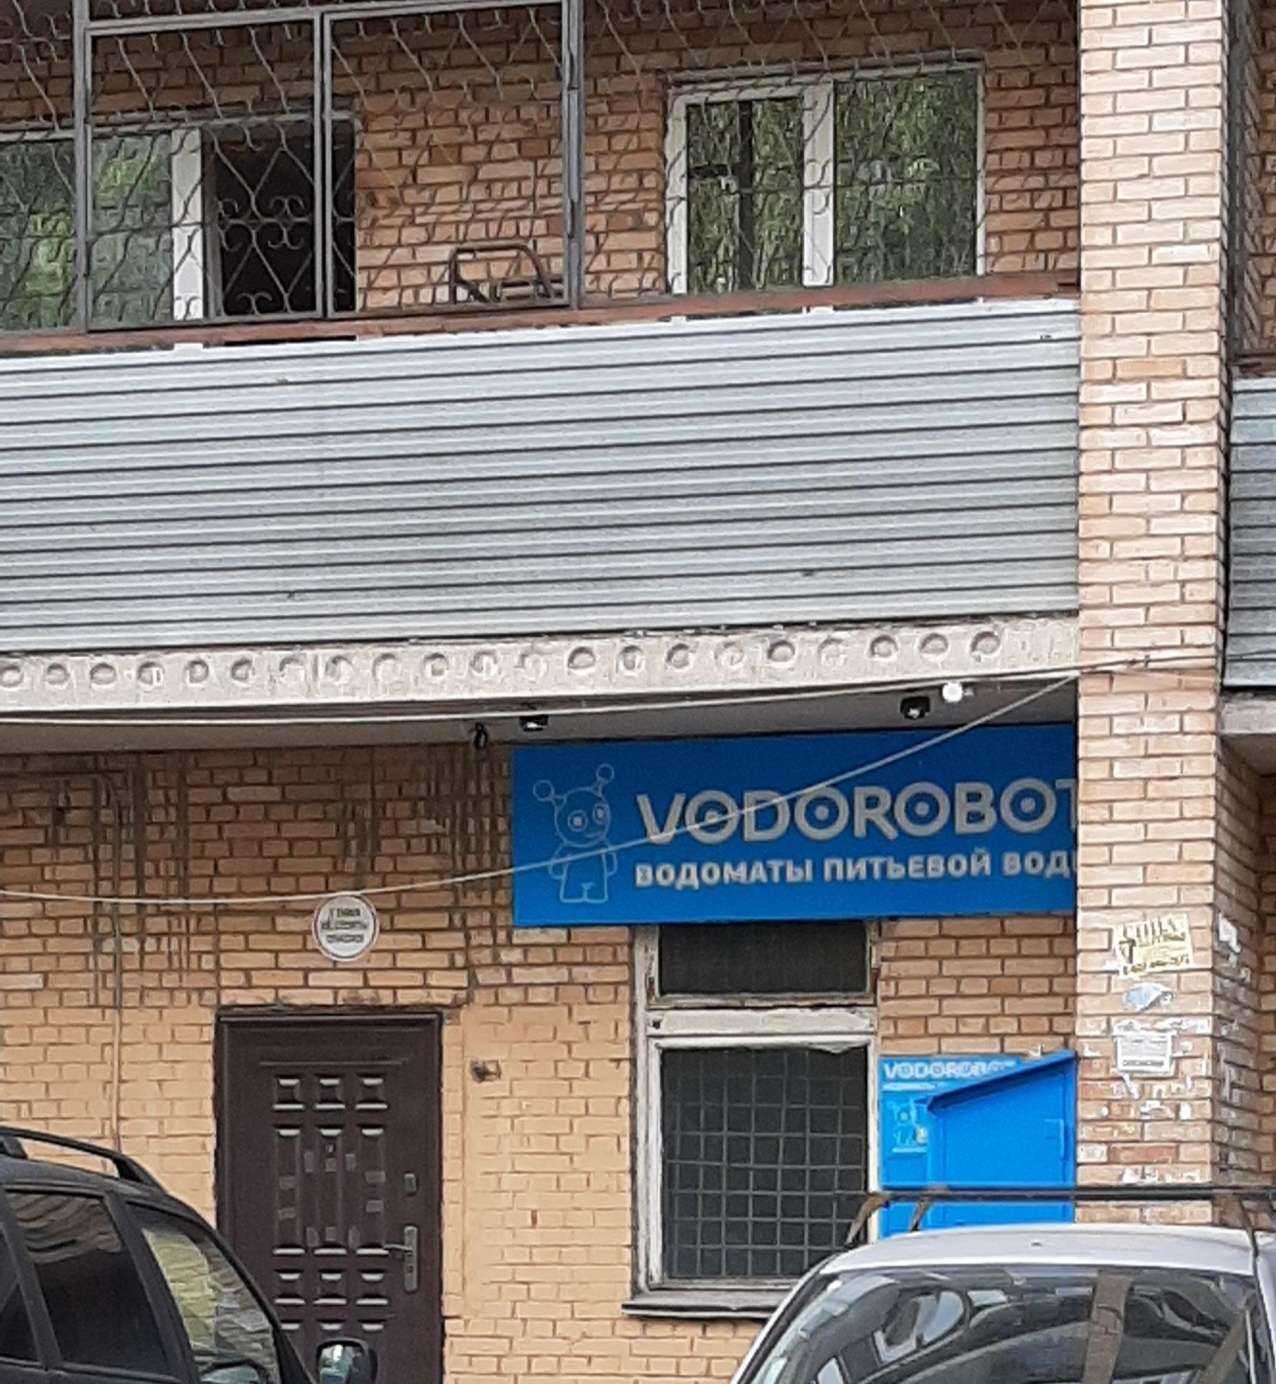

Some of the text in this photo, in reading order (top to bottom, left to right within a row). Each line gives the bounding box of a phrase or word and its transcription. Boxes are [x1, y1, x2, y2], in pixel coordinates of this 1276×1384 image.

[636, 778, 1077, 846] VODOROBOT
[634, 847, 1077, 891] ВОДОМАТЫ ПИТЬЕВОЙ ВОД
